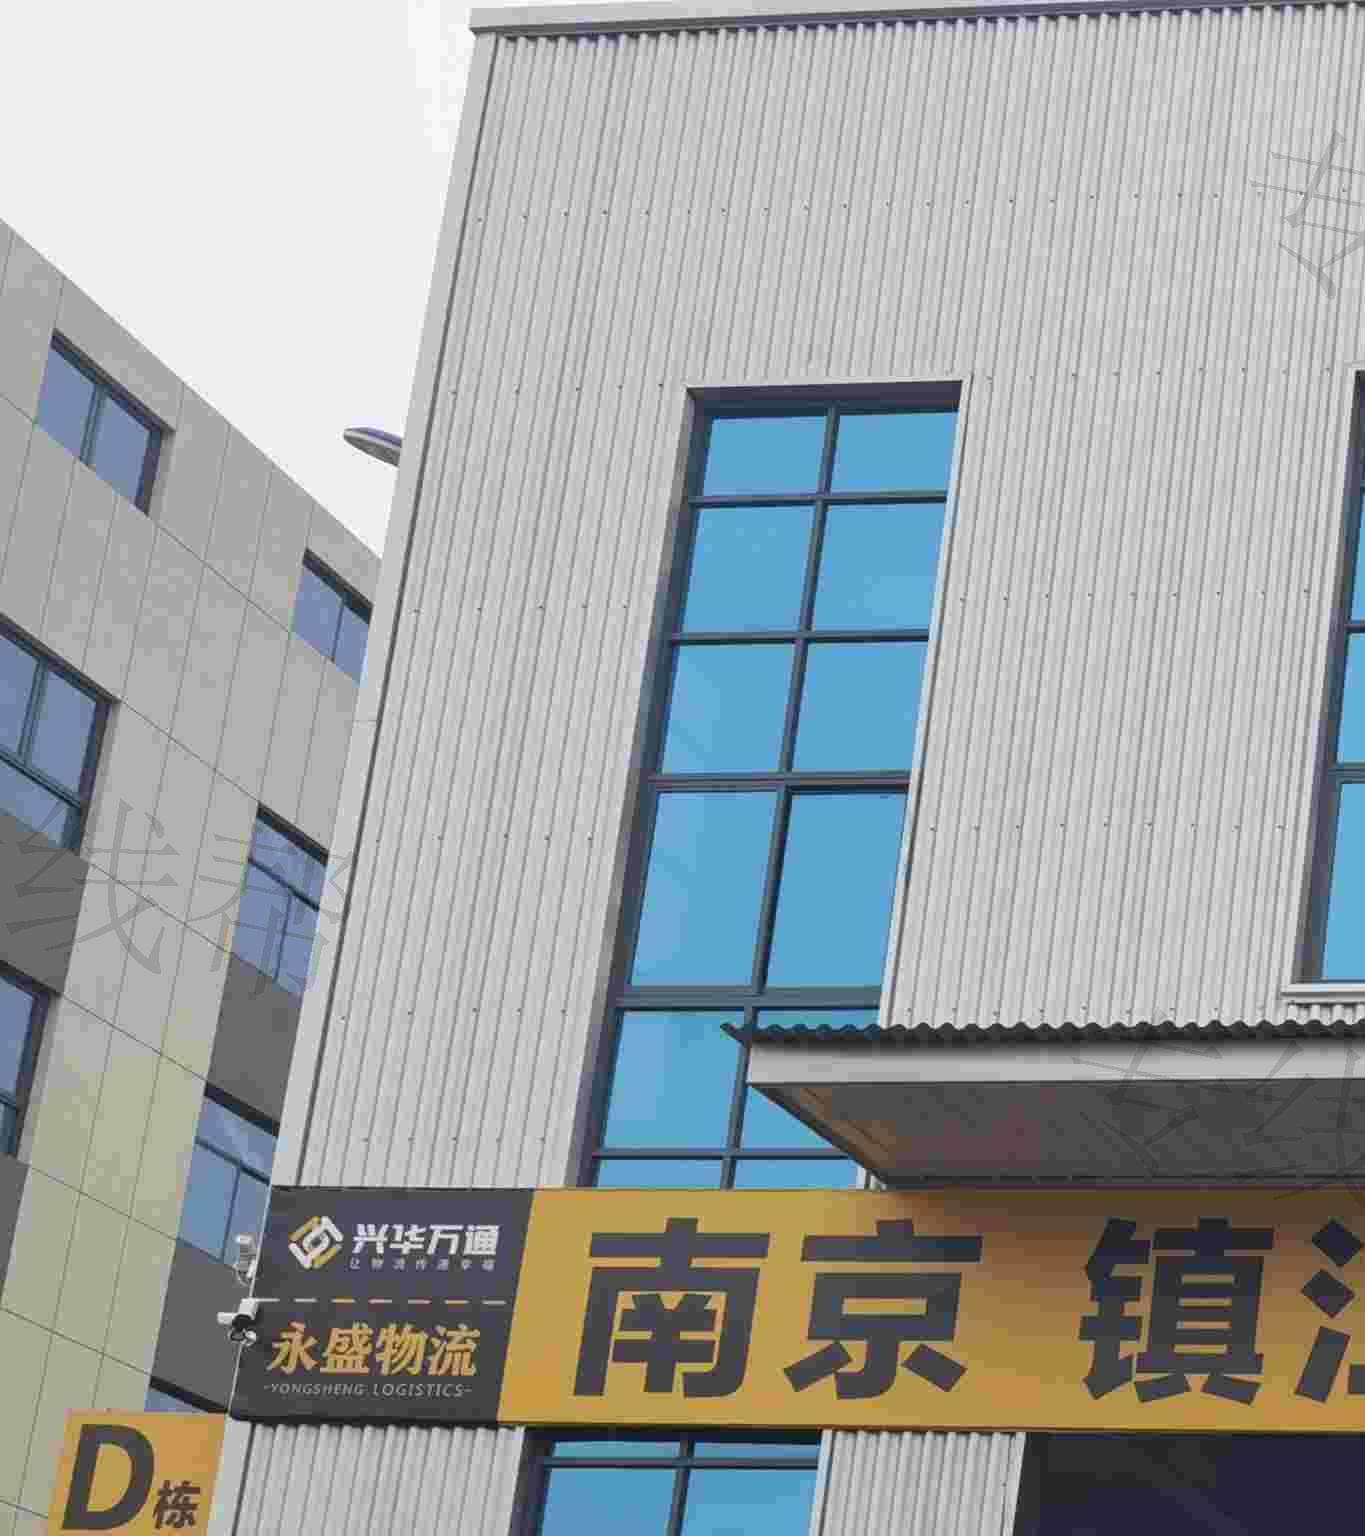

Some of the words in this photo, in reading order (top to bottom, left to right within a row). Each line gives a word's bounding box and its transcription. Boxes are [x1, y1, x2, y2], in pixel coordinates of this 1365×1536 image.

[352, 1224, 500, 1256] 兴华万通
[572, 1217, 984, 1400] 南京
[265, 1320, 480, 1377] 永盛物流
[270, 1383, 367, 1396] YONGSHENG
[373, 1384, 465, 1397] LOGISTICS
[61, 1423, 200, 1530] D栋
